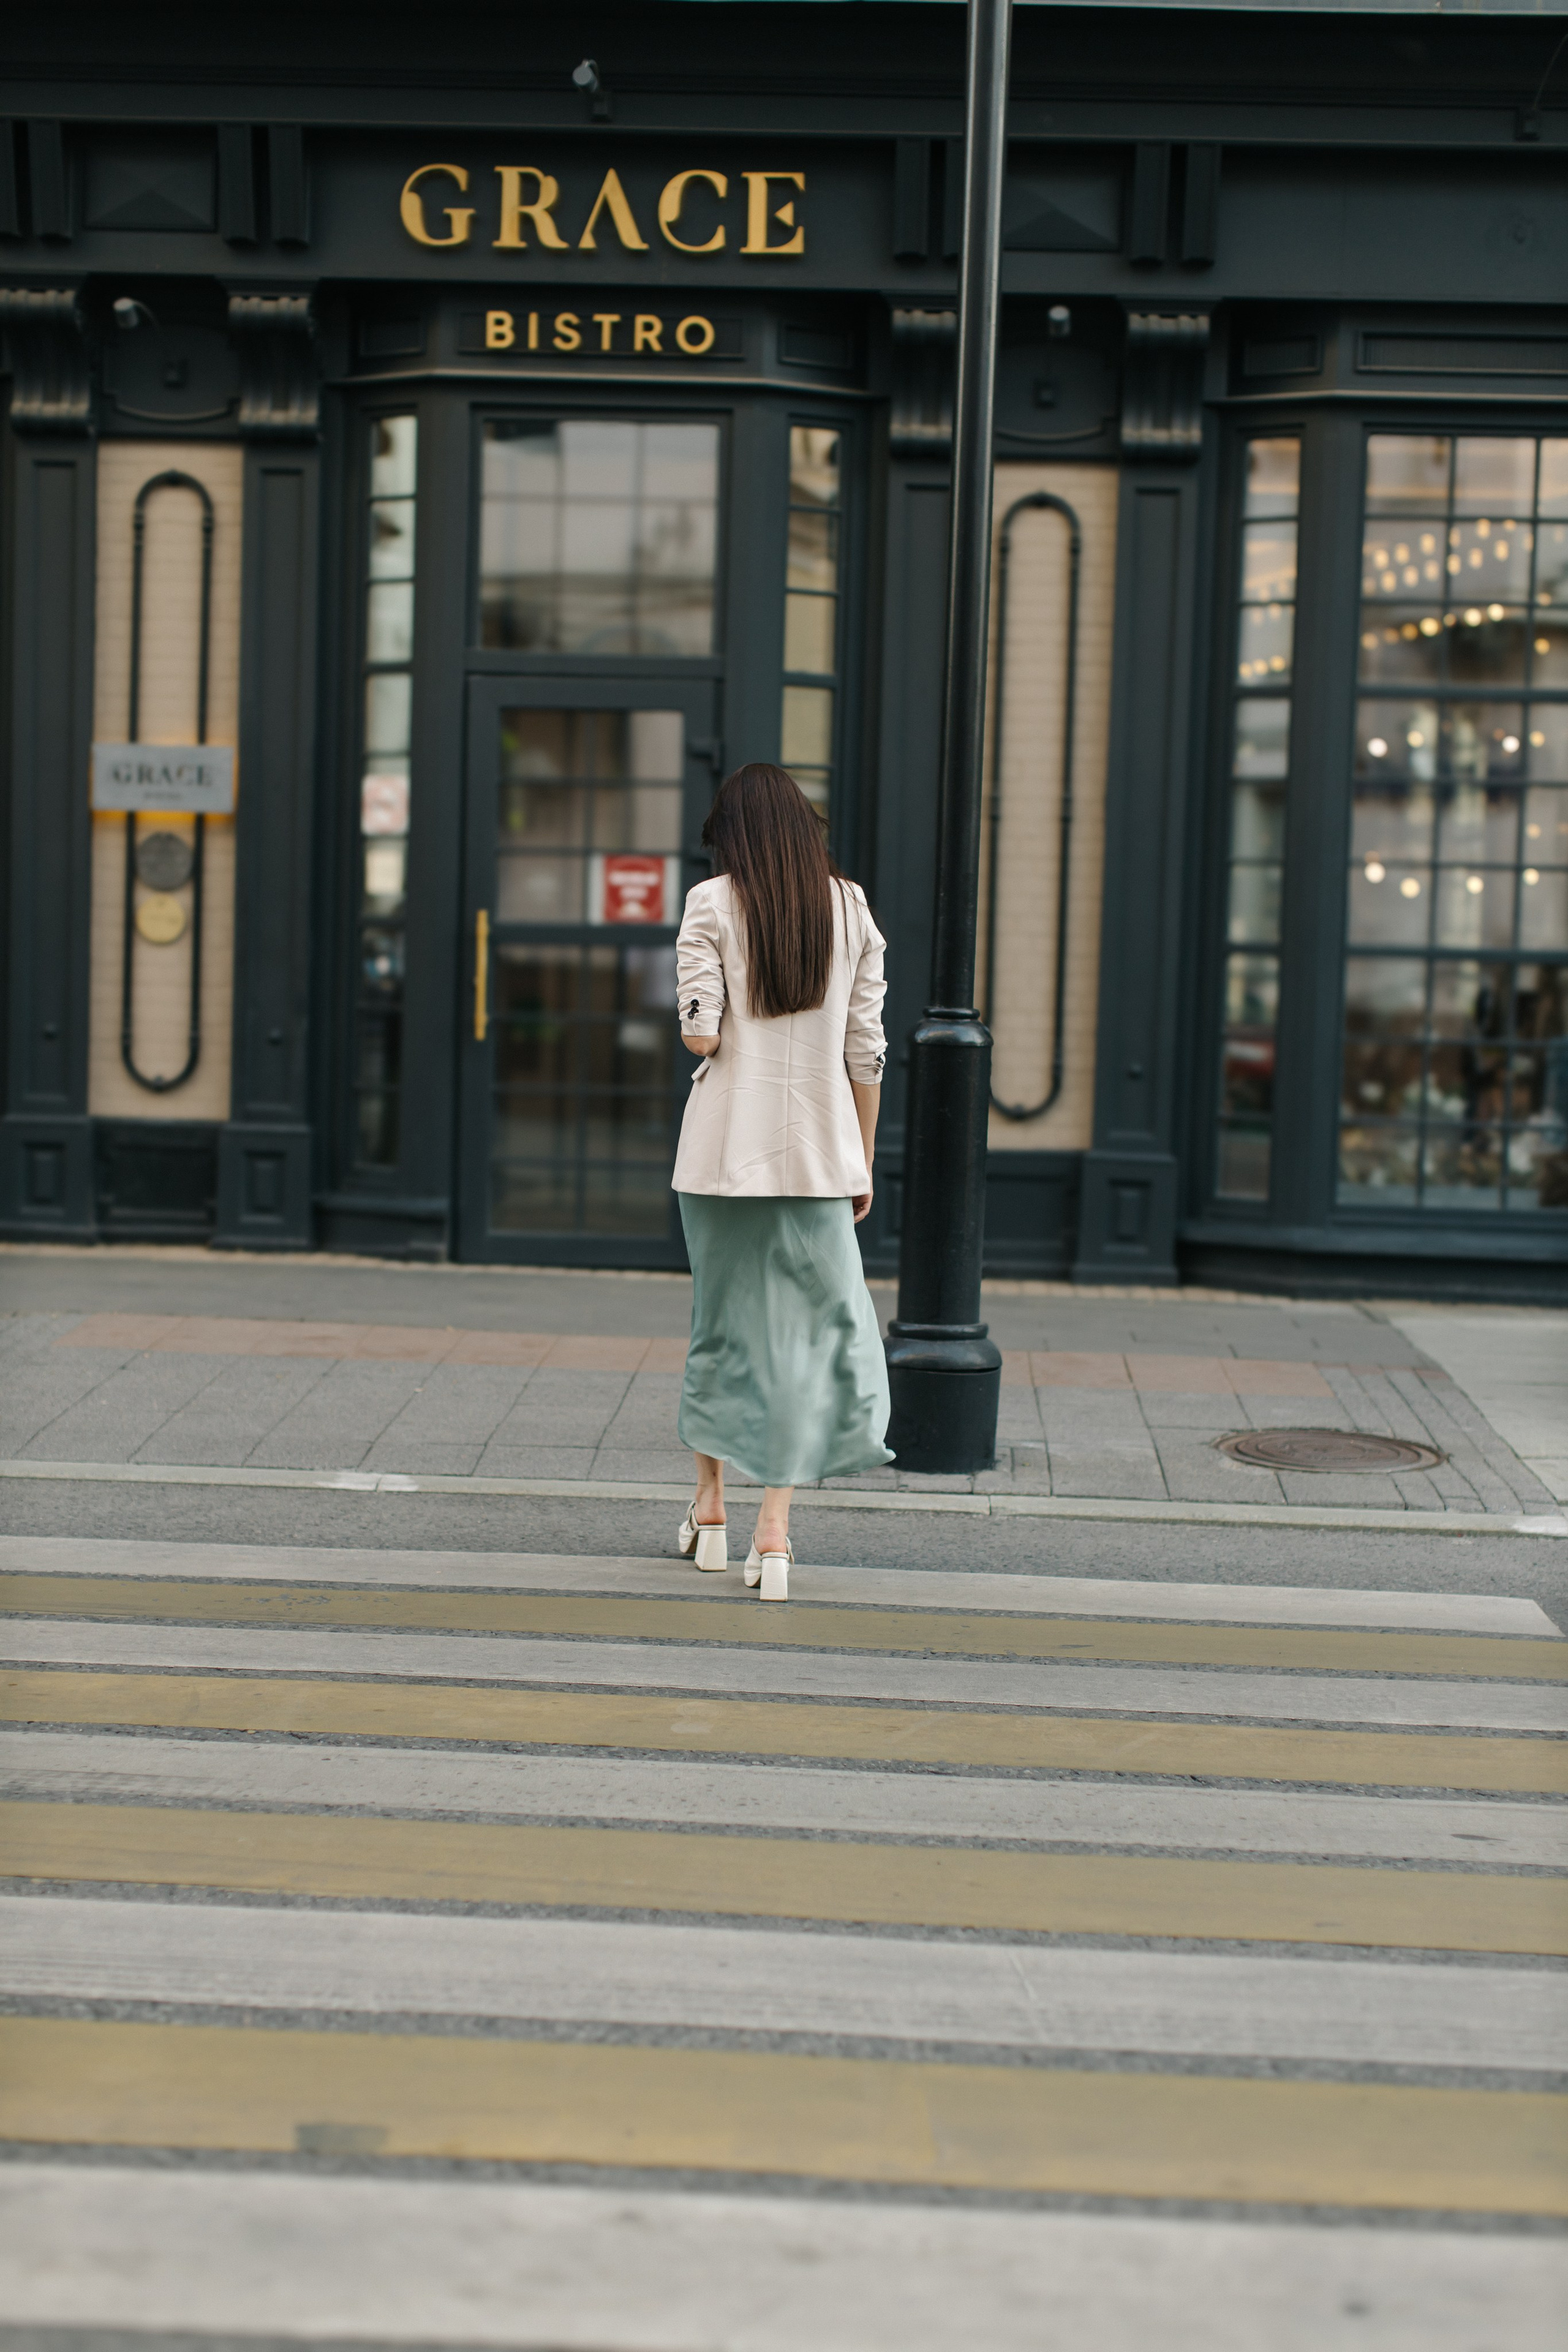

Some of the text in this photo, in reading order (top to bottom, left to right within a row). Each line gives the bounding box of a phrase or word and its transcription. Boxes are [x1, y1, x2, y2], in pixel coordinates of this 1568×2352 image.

[400, 163, 805, 254] GRACE
[486, 311, 715, 353] BISTRO
[111, 763, 213, 787] GRACE
